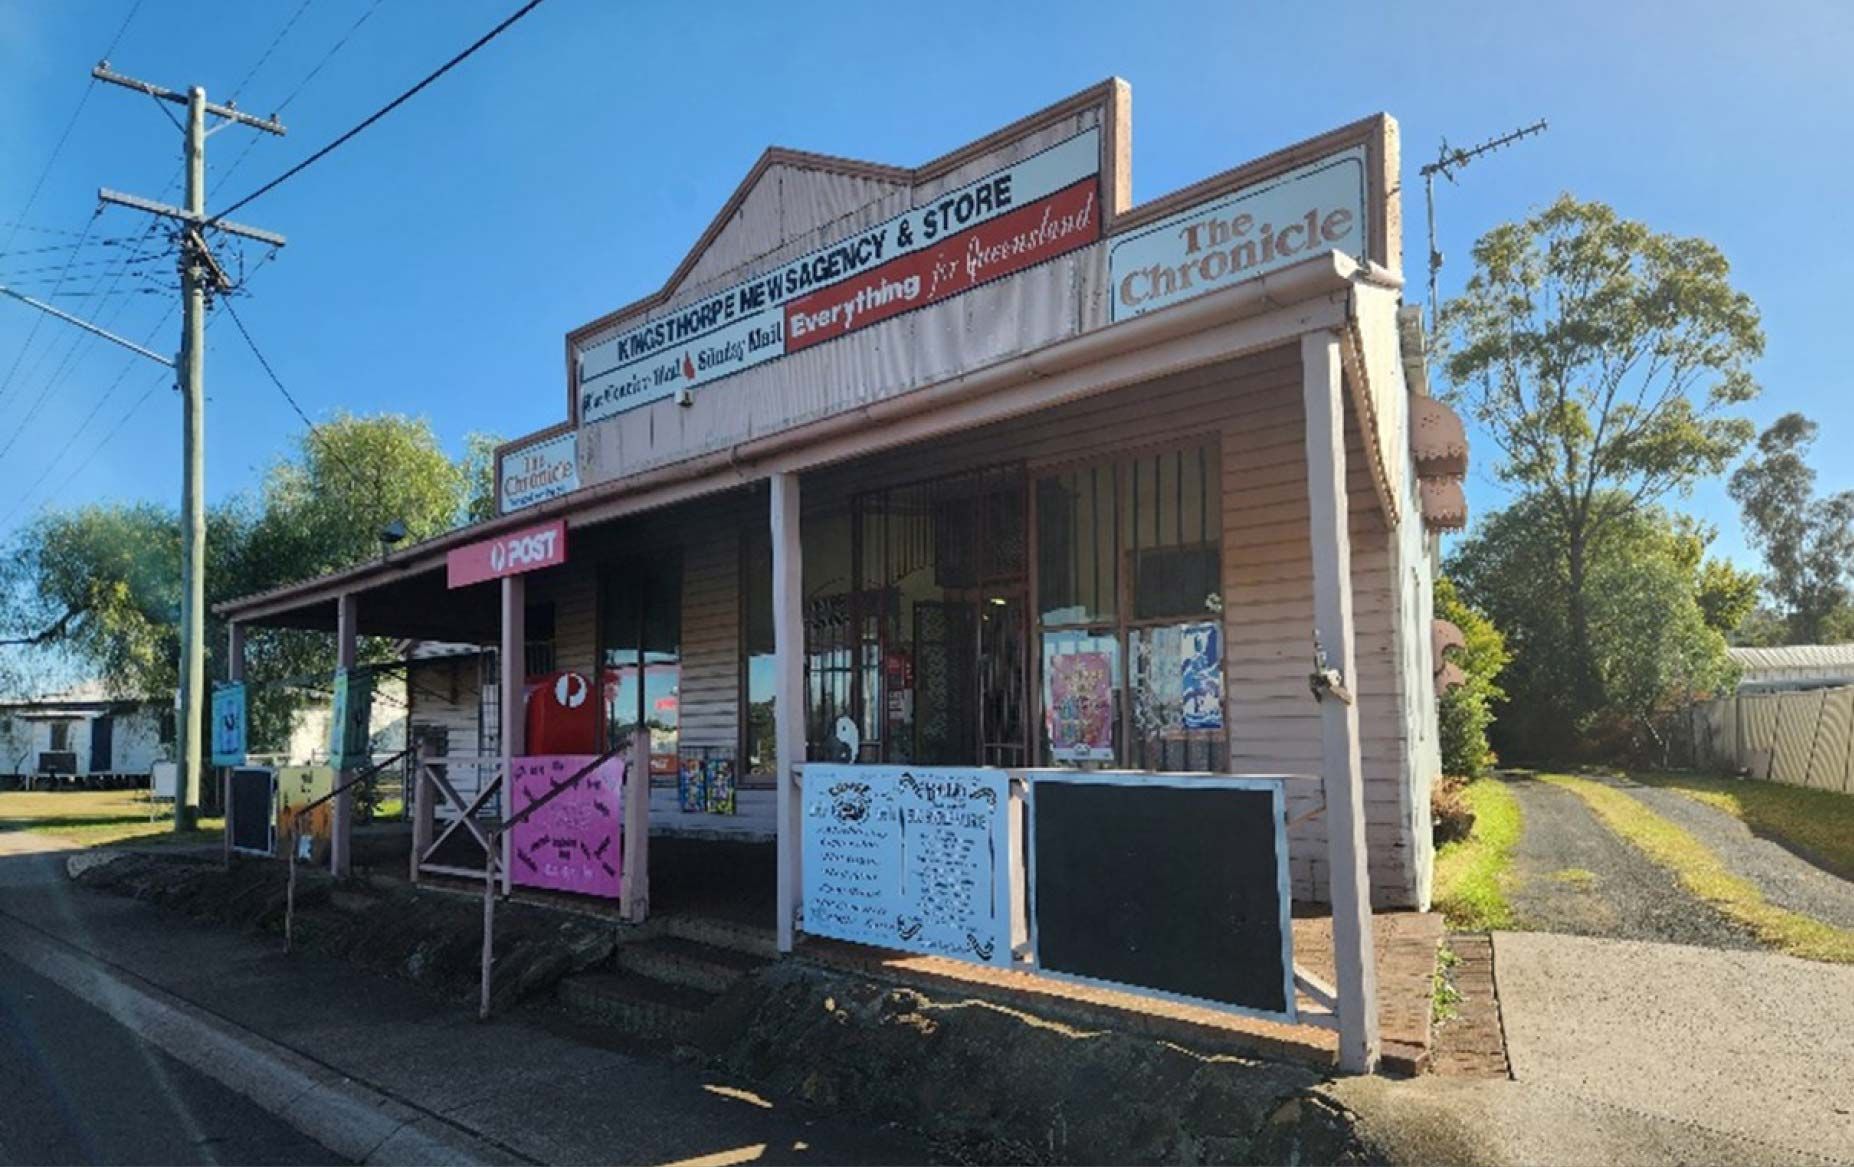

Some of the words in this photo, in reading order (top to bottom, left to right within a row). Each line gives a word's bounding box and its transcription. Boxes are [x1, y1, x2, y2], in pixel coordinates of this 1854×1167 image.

[617, 292, 736, 362] KINGSTHORPE
[739, 229, 887, 314] NEWSAGENCY
[897, 219, 914, 249] &
[922, 173, 1013, 240] STORE
[790, 273, 922, 339] Everything
[927, 252, 960, 299] for
[965, 190, 1095, 283] Queensland
[1120, 207, 1354, 307] Chronicle
[1178, 211, 1254, 256] The
[748, 320, 783, 353] Mail
[508, 528, 558, 568] POST
